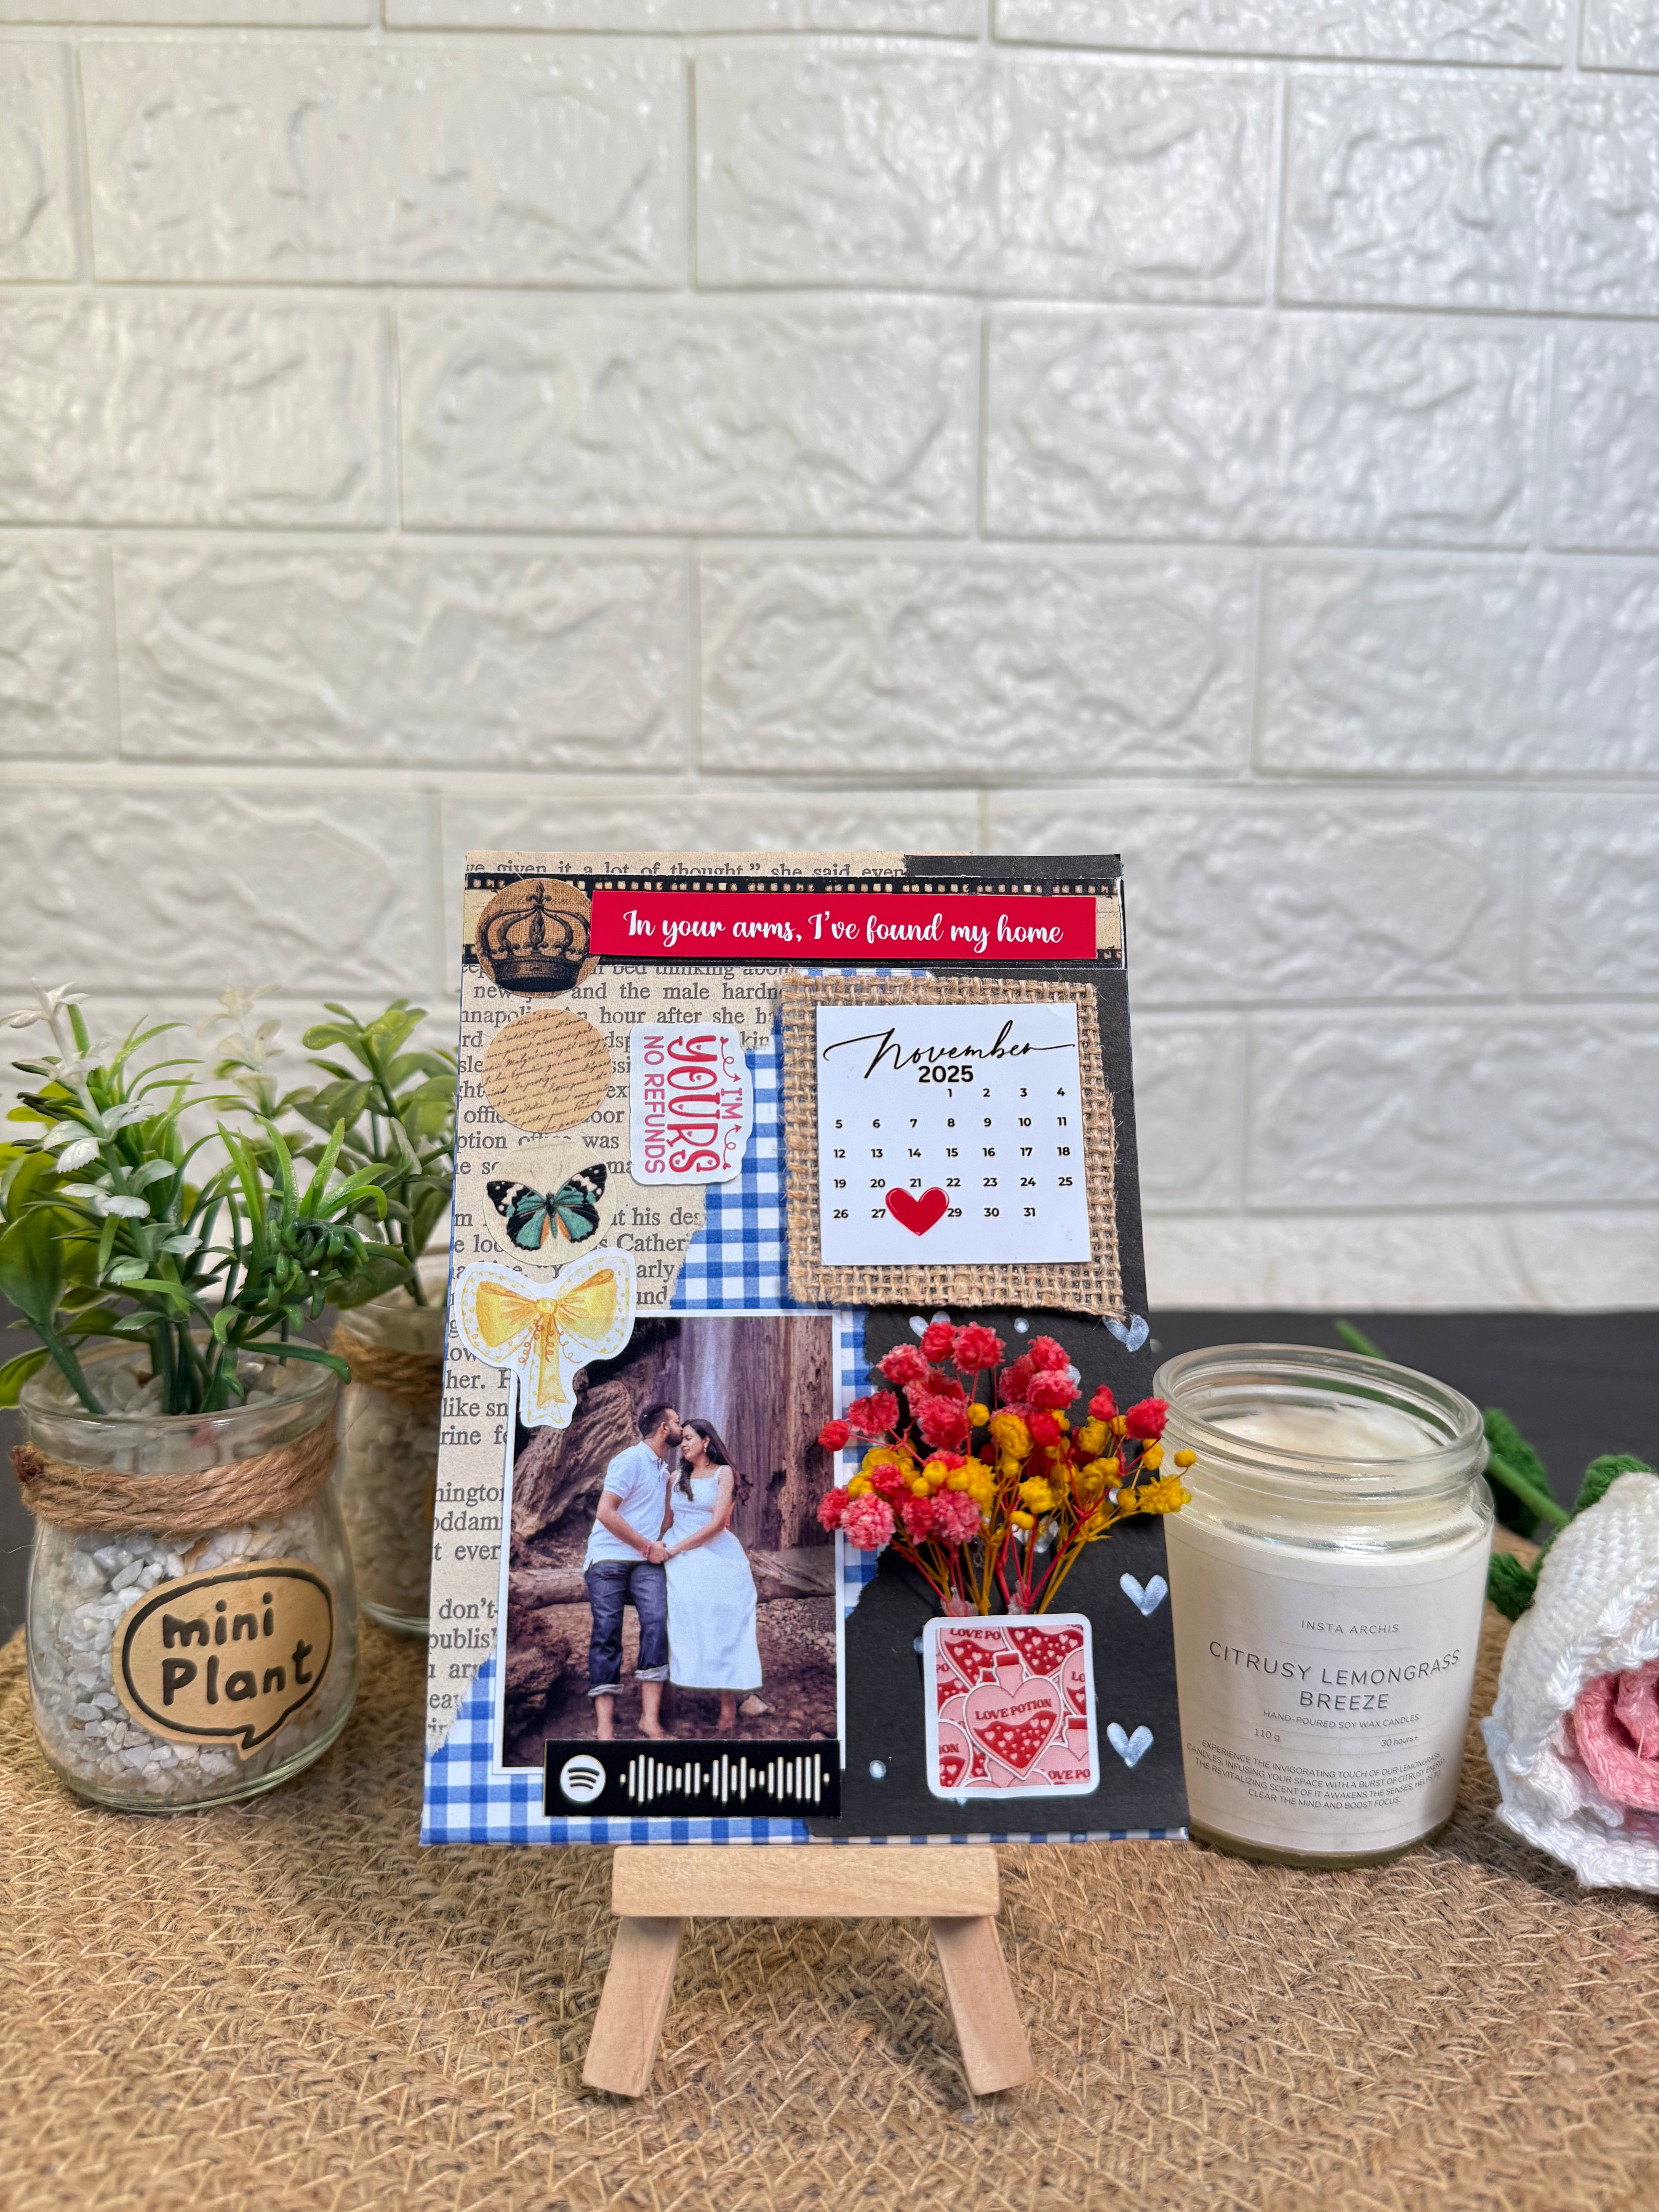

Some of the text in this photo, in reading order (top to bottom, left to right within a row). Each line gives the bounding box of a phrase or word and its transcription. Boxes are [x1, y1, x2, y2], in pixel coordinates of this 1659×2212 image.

[771, 864, 802, 875] she
[623, 909, 1064, 953] In your arms, I’ve found my home
[572, 982, 782, 999] and the male hardn
[600, 1007, 646, 1023] hour
[657, 1007, 702, 1023] after
[713, 1007, 744, 1023] she
[823, 1020, 1076, 1078] November
[918, 1065, 973, 1083] 2025
[606, 1085, 630, 1098] ex
[947, 1087, 1065, 1097] 1 2 3 4
[644, 1036, 665, 1173] NO REFUNDS
[667, 1035, 720, 1173] YOURS
[721, 1087, 743, 1119] I'M
[587, 1110, 624, 1123] oor
[836, 1117, 1067, 1128] 5 6 7 8 9 10 11
[582, 1136, 619, 1148] was
[833, 1147, 1071, 1158] 12 13 14 15 16 17 18
[834, 1177, 1073, 1188] 19 20 21 22 23 24 25
[632, 1207, 660, 1226] his
[833, 1209, 886, 1218] 26 27
[948, 1208, 1036, 1217] 29 30 31
[446, 1370, 485, 1389] her.
[442, 1397, 480, 1417] like
[441, 1425, 481, 1445] rine
[454, 1545, 501, 1560] ever
[162, 1591, 274, 1649] mini
[1301, 1620, 1400, 1634] INSTA ARCHIS
[1210, 1641, 1460, 1684] CITRUSY LEMONGRASS
[162, 1639, 313, 1706] Plant
[975, 1698, 1052, 1720] LOVE POTION
[1300, 1691, 1389, 1710] BREEZE
[1263, 1710, 1336, 1728] HAND-POURED
[1383, 1714, 1419, 1726] CANDLES
[1254, 1728, 1280, 1742] 110 g
[1381, 1735, 1418, 1747] 30 hours+
[1187, 1743, 1223, 1765] CANDLES,
[1225, 1760, 1265, 1777] INFUSING
[1267, 1772, 1292, 1783] YOUR
[1294, 1777, 1323, 1787] SPACE
[1359, 1779, 1385, 1788] BURST
[1202, 1740, 1251, 1763] EXPERIENCE
[1253, 1758, 1270, 1768] THE
[1272, 1763, 1335, 1778] INVIGORATING
[1382, 1767, 1398, 1775] OUR
[1195, 1757, 1210, 1770] THE
[1211, 1765, 1267, 1789] REVITALIZING
[1269, 1783, 1298, 1794] SCENT
[1324, 1790, 1367, 1799] AWAKENS
[1248, 1789, 1276, 1802] CLEAR
[1279, 1796, 1297, 1805] THE
[1299, 1799, 1321, 1808] MIND
[1344, 1801, 1373, 1809] BOOST
[1374, 1796, 1400, 1807] FOCUS.
